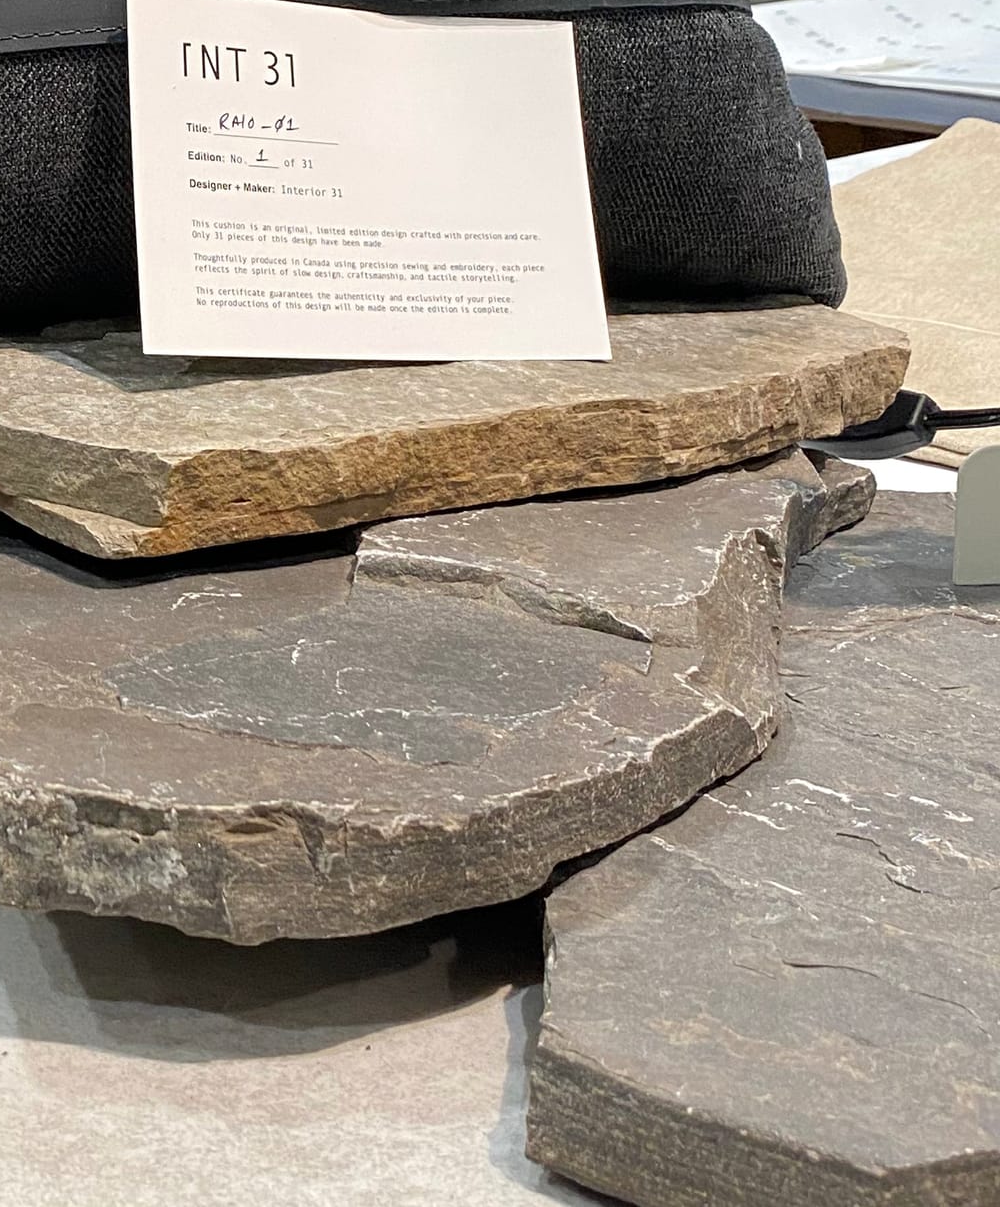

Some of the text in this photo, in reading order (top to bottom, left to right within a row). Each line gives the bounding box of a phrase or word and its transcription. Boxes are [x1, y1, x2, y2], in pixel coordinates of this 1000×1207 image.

[183, 43, 295, 87] INT 31
[186, 123, 211, 133] Title:
[188, 151, 225, 162] Edition:
[256, 149, 268, 161] 1
[284, 159, 294, 167] of
[302, 160, 313, 169] 31
[190, 179, 231, 191] Designer
[244, 183, 275, 193] Maker:
[282, 185, 326, 197] Interior
[332, 188, 342, 198] 31
[192, 220, 209, 228] This
[214, 221, 245, 230] cushion
[250, 223, 258, 231] is
[317, 226, 345, 235] limited
[350, 228, 378, 236] edition
[382, 230, 407, 238] design
[411, 231, 441, 239] crafted
[464, 233, 502, 241] precision
[192, 231, 210, 240] Only
[228, 233, 254, 241] pieces
[272, 234, 287, 243] this
[292, 236, 317, 245] design
[321, 238, 338, 246] have
[194, 253, 247, 264] Thoughtfully
[251, 257, 287, 266] produced
[303, 258, 330, 267] Canada
[334, 260, 356, 269] using
[360, 262, 398, 271] precision
[402, 263, 429, 271] sewing
[195, 265, 229, 273] reflects
[235, 266, 247, 274] the
[252, 267, 276, 276] spirit
[293, 269, 311, 277] slow
[196, 287, 214, 295] This
[218, 288, 265, 297] certificate
[270, 291, 313, 299] guarantees
[335, 293, 385, 302] authenticity
[407, 295, 451, 303] exclusivity
[467, 296, 484, 304] your
[211, 300, 269, 308] reproductions
[286, 302, 301, 310] this
[305, 303, 331, 312] design
